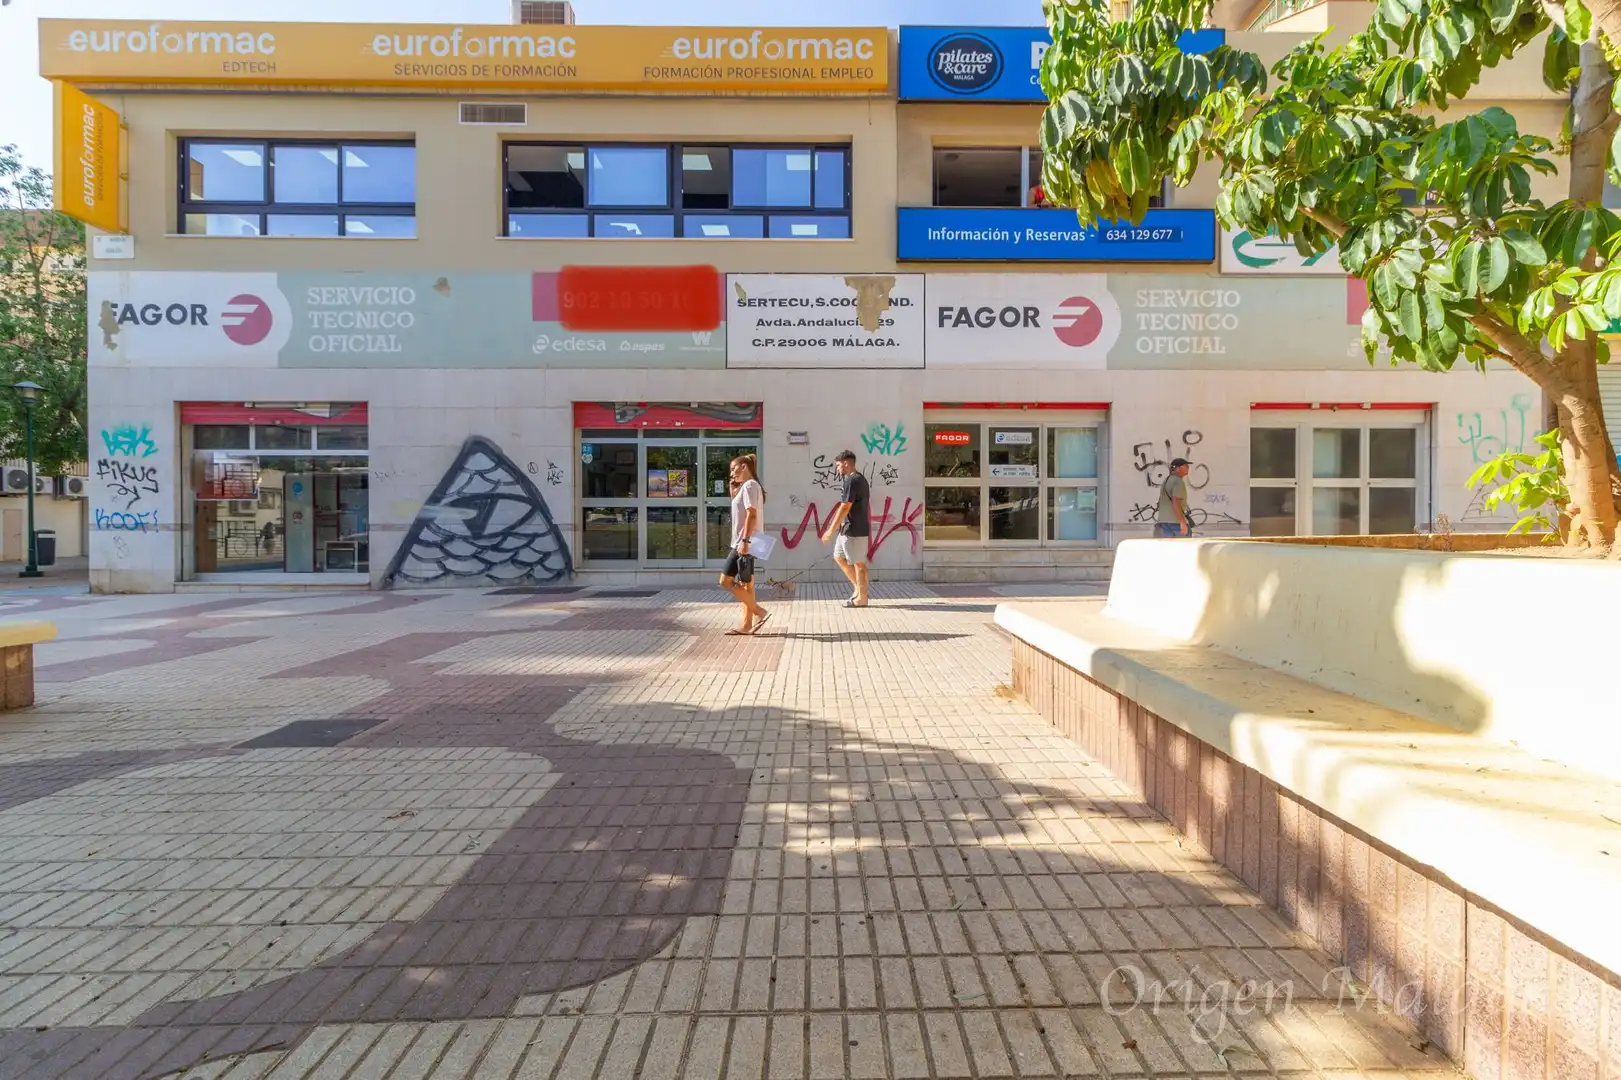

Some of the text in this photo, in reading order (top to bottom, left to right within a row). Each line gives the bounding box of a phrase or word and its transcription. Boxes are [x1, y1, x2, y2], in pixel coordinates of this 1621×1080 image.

[68, 24, 276, 55] euroformac
[372, 28, 576, 58] euroformac
[672, 31, 874, 60] euroformac
[222, 61, 277, 73] EDTECH
[938, 49, 993, 71] pilates
[394, 62, 577, 77] SERVICIOS DE FORMACIÓN
[644, 65, 874, 80] FORMACIÓN PROFESIONAL EMPLEO
[80, 104, 95, 207] euroformac
[927, 227, 1010, 242] Información
[1013, 231, 1022, 244] y
[1026, 228, 1086, 242] Reservas
[1106, 229, 1128, 241] 634
[1130, 229, 1150, 241] 129
[1151, 229, 1174, 241] 677
[307, 287, 416, 306] SERVICIO
[1135, 290, 1241, 308] SERVICIO
[308, 311, 415, 330] TECNICO
[938, 306, 1040, 329] FAGOR
[1136, 313, 1239, 331] TECNICO
[308, 335, 402, 353] OFICIAL
[552, 337, 607, 352] edesa
[832, 333, 900, 347] MÁLAGA.
[1136, 336, 1226, 354] OFICIAL
